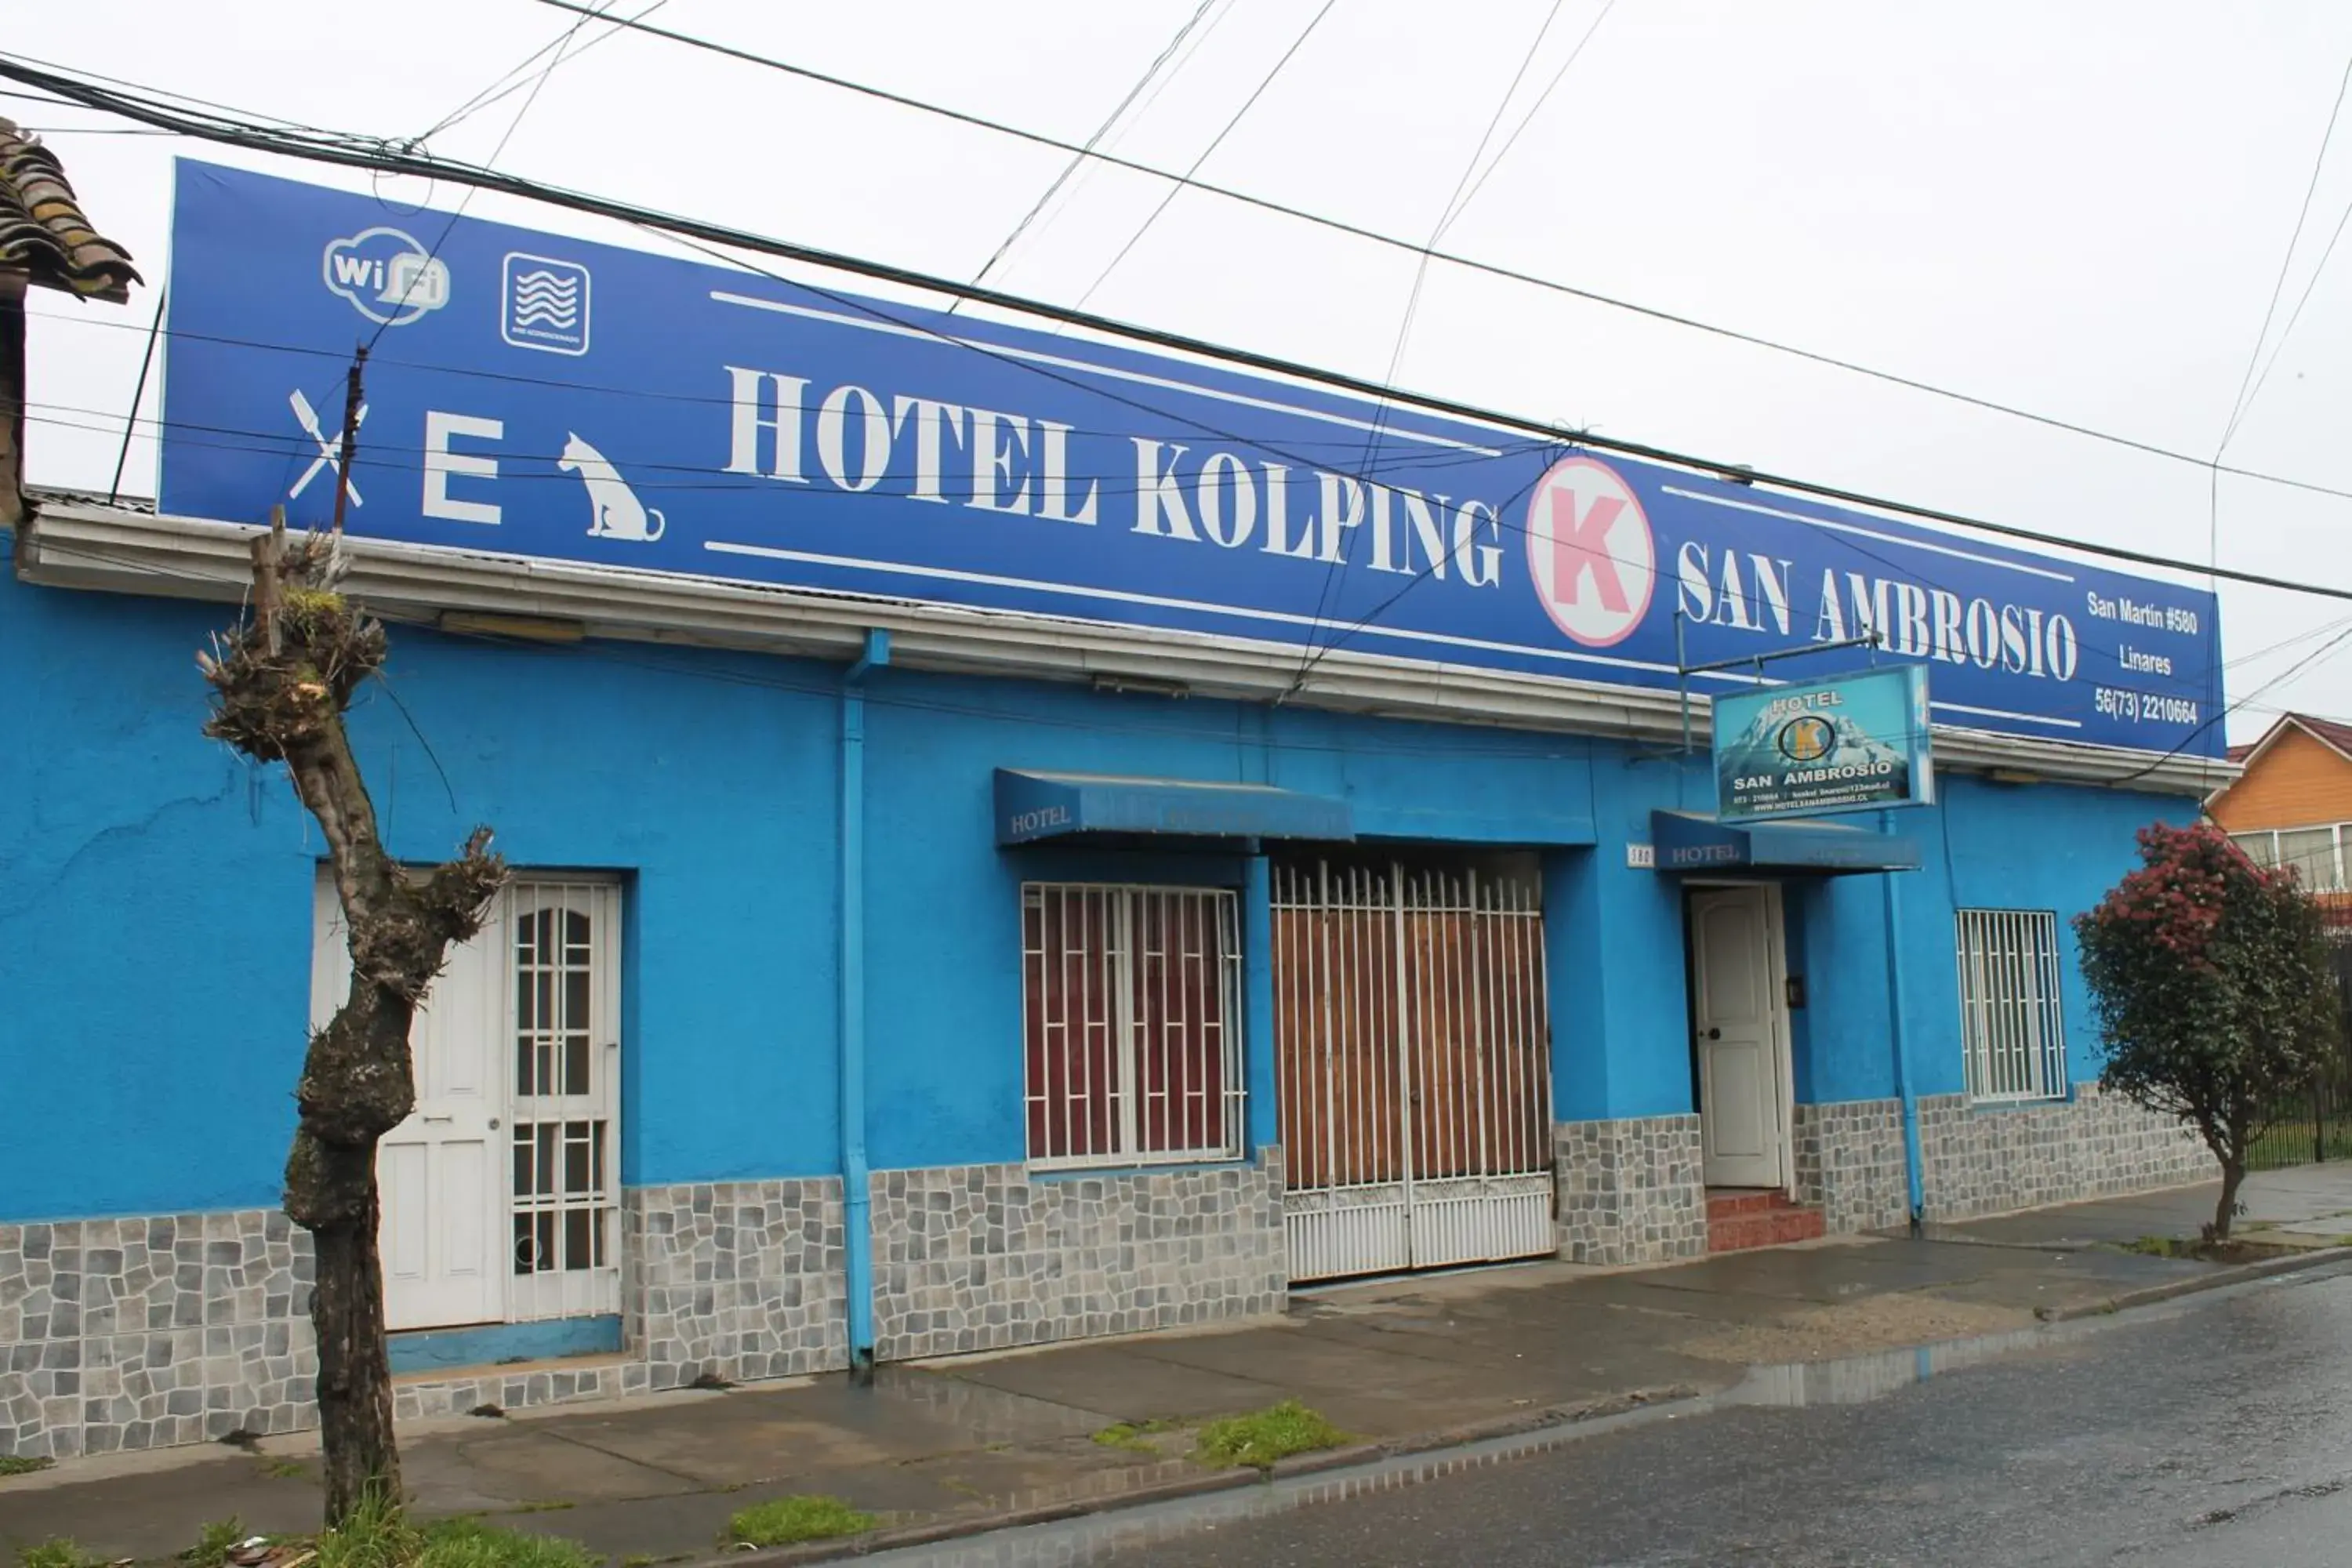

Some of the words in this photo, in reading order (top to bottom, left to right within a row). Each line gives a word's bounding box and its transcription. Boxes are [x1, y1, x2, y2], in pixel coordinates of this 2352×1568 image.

[423, 410, 503, 524] E
[722, 365, 1098, 525] HOTEL
[1130, 437, 1504, 589] KOLPING
[1551, 485, 1632, 615] K
[1677, 541, 1792, 636] SAN
[1812, 568, 2078, 681] AMBROSIO
[2087, 590, 2116, 619] San
[2166, 606, 2198, 635] #580
[2119, 644, 2171, 676] Linares
[1770, 690, 1843, 716] HOTEL
[2095, 688, 2139, 723] 56(73)
[2142, 694, 2198, 724] 2210664
[1733, 775, 1772, 790] SAN
[1784, 761, 1892, 786] AMBROSIO
[1011, 806, 1072, 834] HOTEL
[1672, 844, 1738, 863] HOTEL
